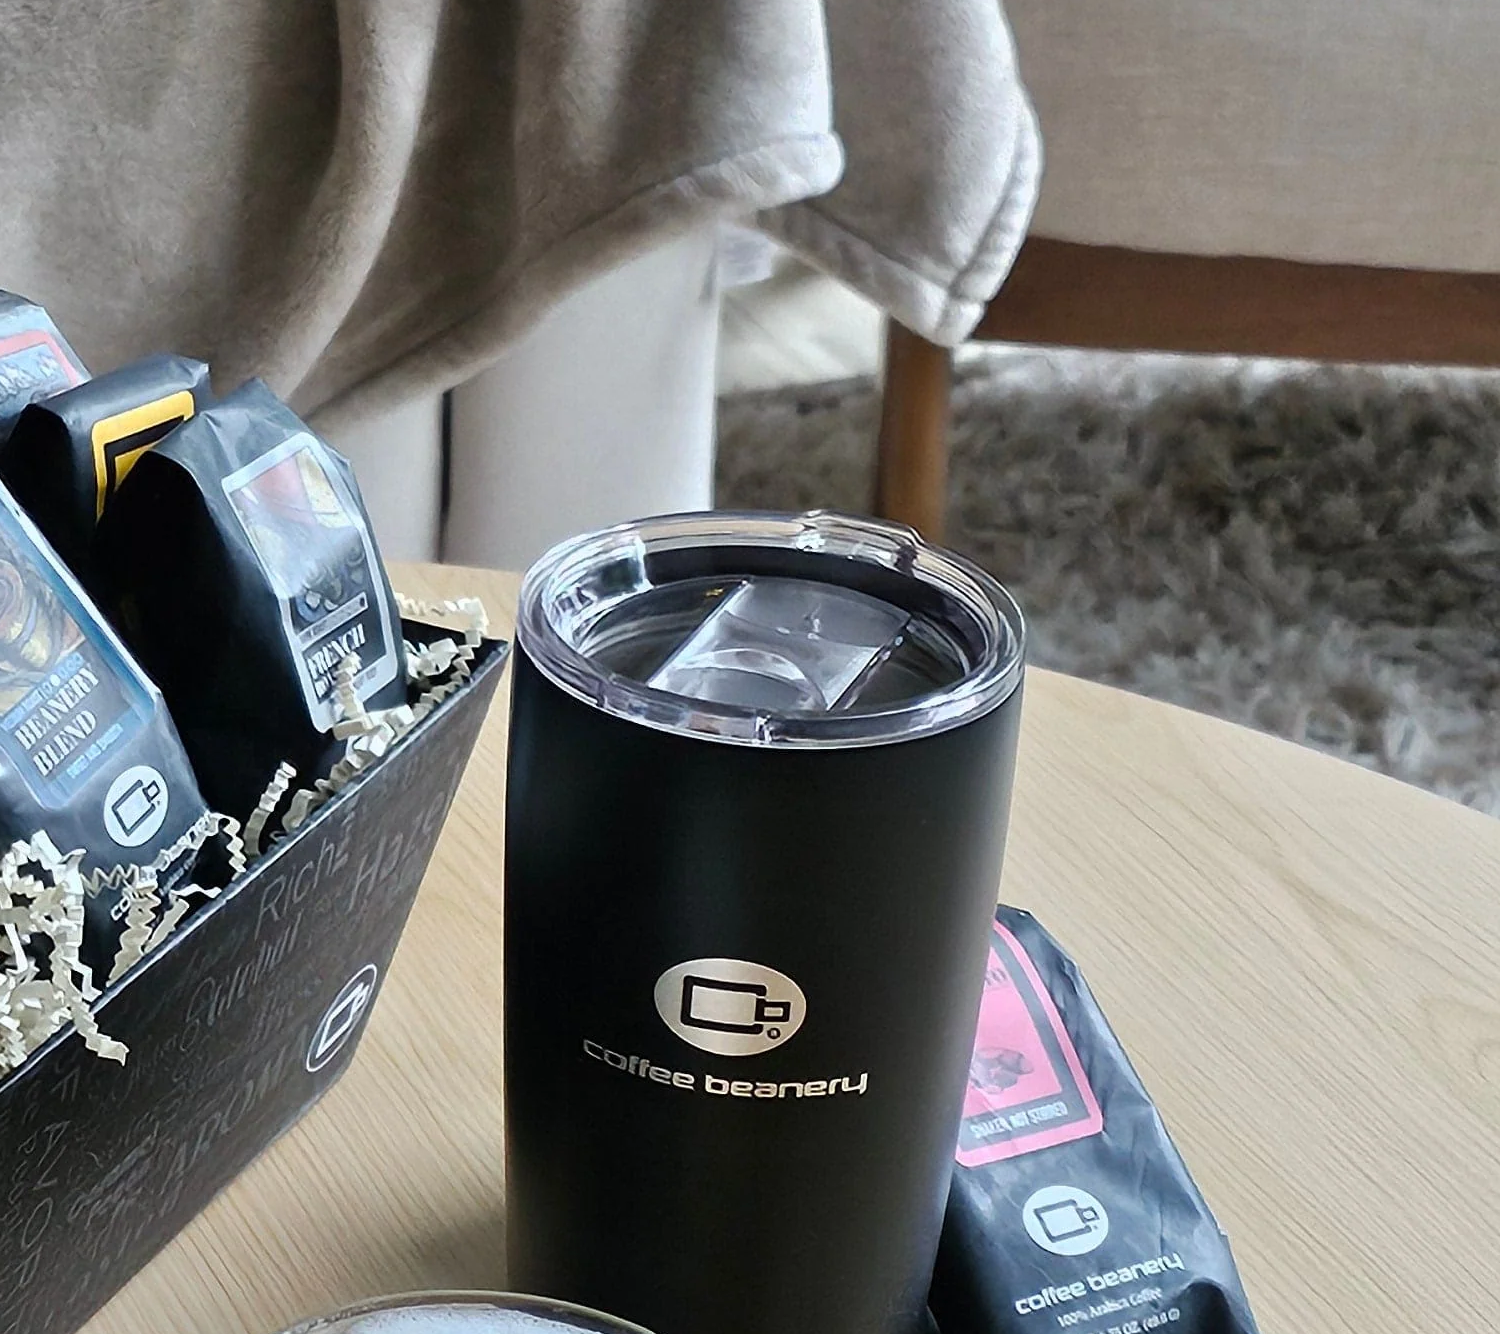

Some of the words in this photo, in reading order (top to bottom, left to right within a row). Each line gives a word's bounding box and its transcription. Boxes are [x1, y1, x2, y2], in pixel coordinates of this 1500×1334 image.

[14, 663, 99, 751] BEANERY
[33, 710, 97, 777] BLEND
[582, 1038, 695, 1093] coffee
[705, 1071, 869, 1100] beanery
[1014, 1281, 1087, 1315] coffee
[1086, 1252, 1186, 1292] beanery
